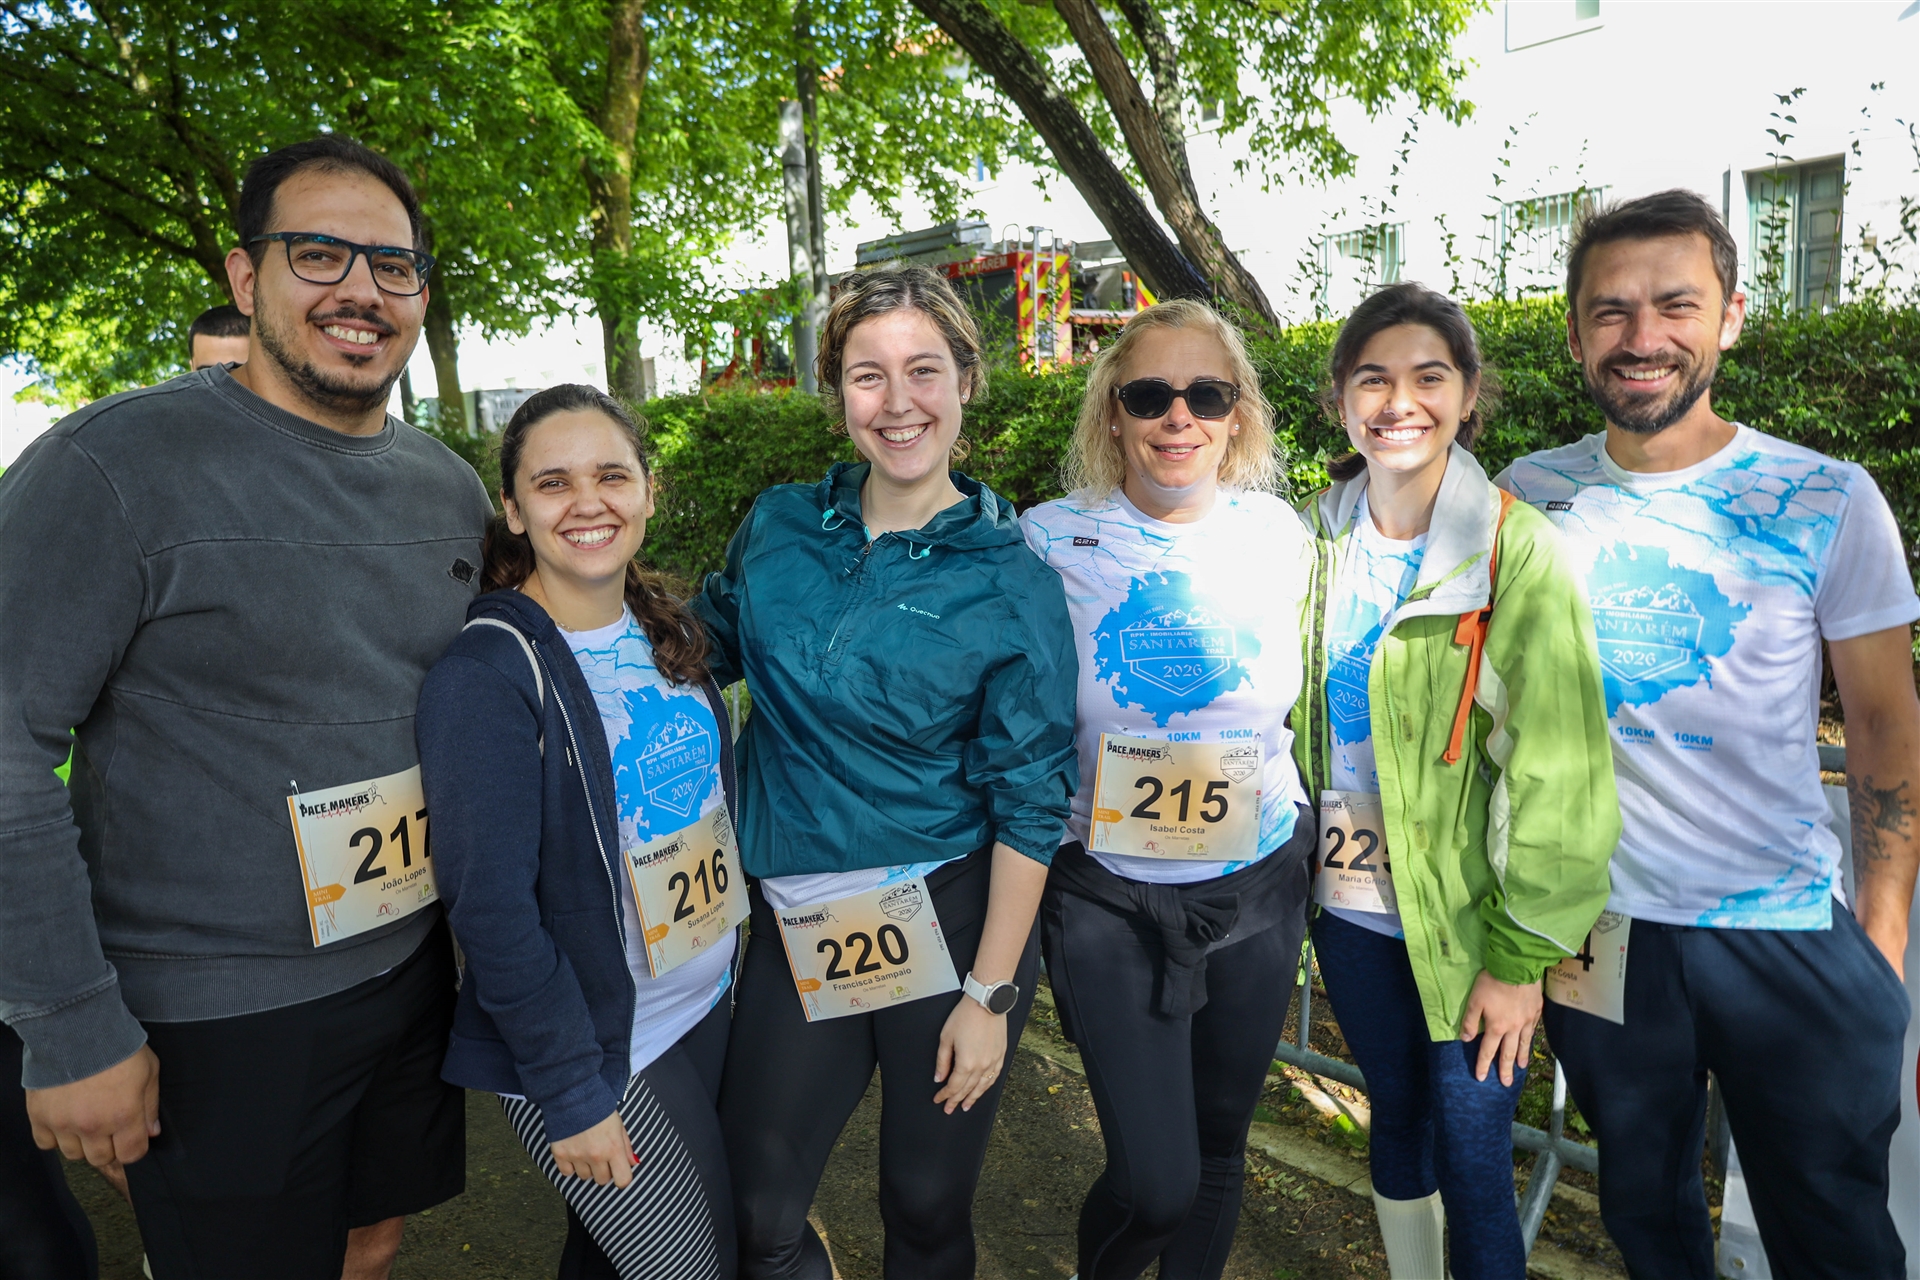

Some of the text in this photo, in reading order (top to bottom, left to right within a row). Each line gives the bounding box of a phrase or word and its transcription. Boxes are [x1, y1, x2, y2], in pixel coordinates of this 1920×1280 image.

[1595, 618, 1688, 638] ANTARÉM
[1129, 635, 1226, 650] SANTARÉM
[1612, 649, 1657, 667] 2026
[1163, 664, 1203, 678] 2026
[1334, 689, 1366, 709] 2026
[1167, 732, 1201, 742] 10KM
[1218, 729, 1253, 739] 10KM
[1617, 726, 1655, 739] 10KM
[1673, 732, 1714, 746] 10KM
[647, 744, 706, 779] SANTARÉM
[671, 779, 694, 802] 2026
[1130, 775, 1229, 823] 215
[1150, 824, 1206, 835] Isabel Costa
[381, 866, 427, 891] João Lopes
[668, 848, 729, 923] 216
[1338, 874, 1387, 886] Maria Grilo
[313, 888, 328, 897] MINI
[314, 894, 332, 903] TRAIL
[687, 911, 710, 929] Susana
[710, 900, 725, 915] Lopes
[816, 923, 909, 981] 220
[833, 968, 912, 991] Francisca Sampaio
[1558, 968, 1578, 981] Costa
